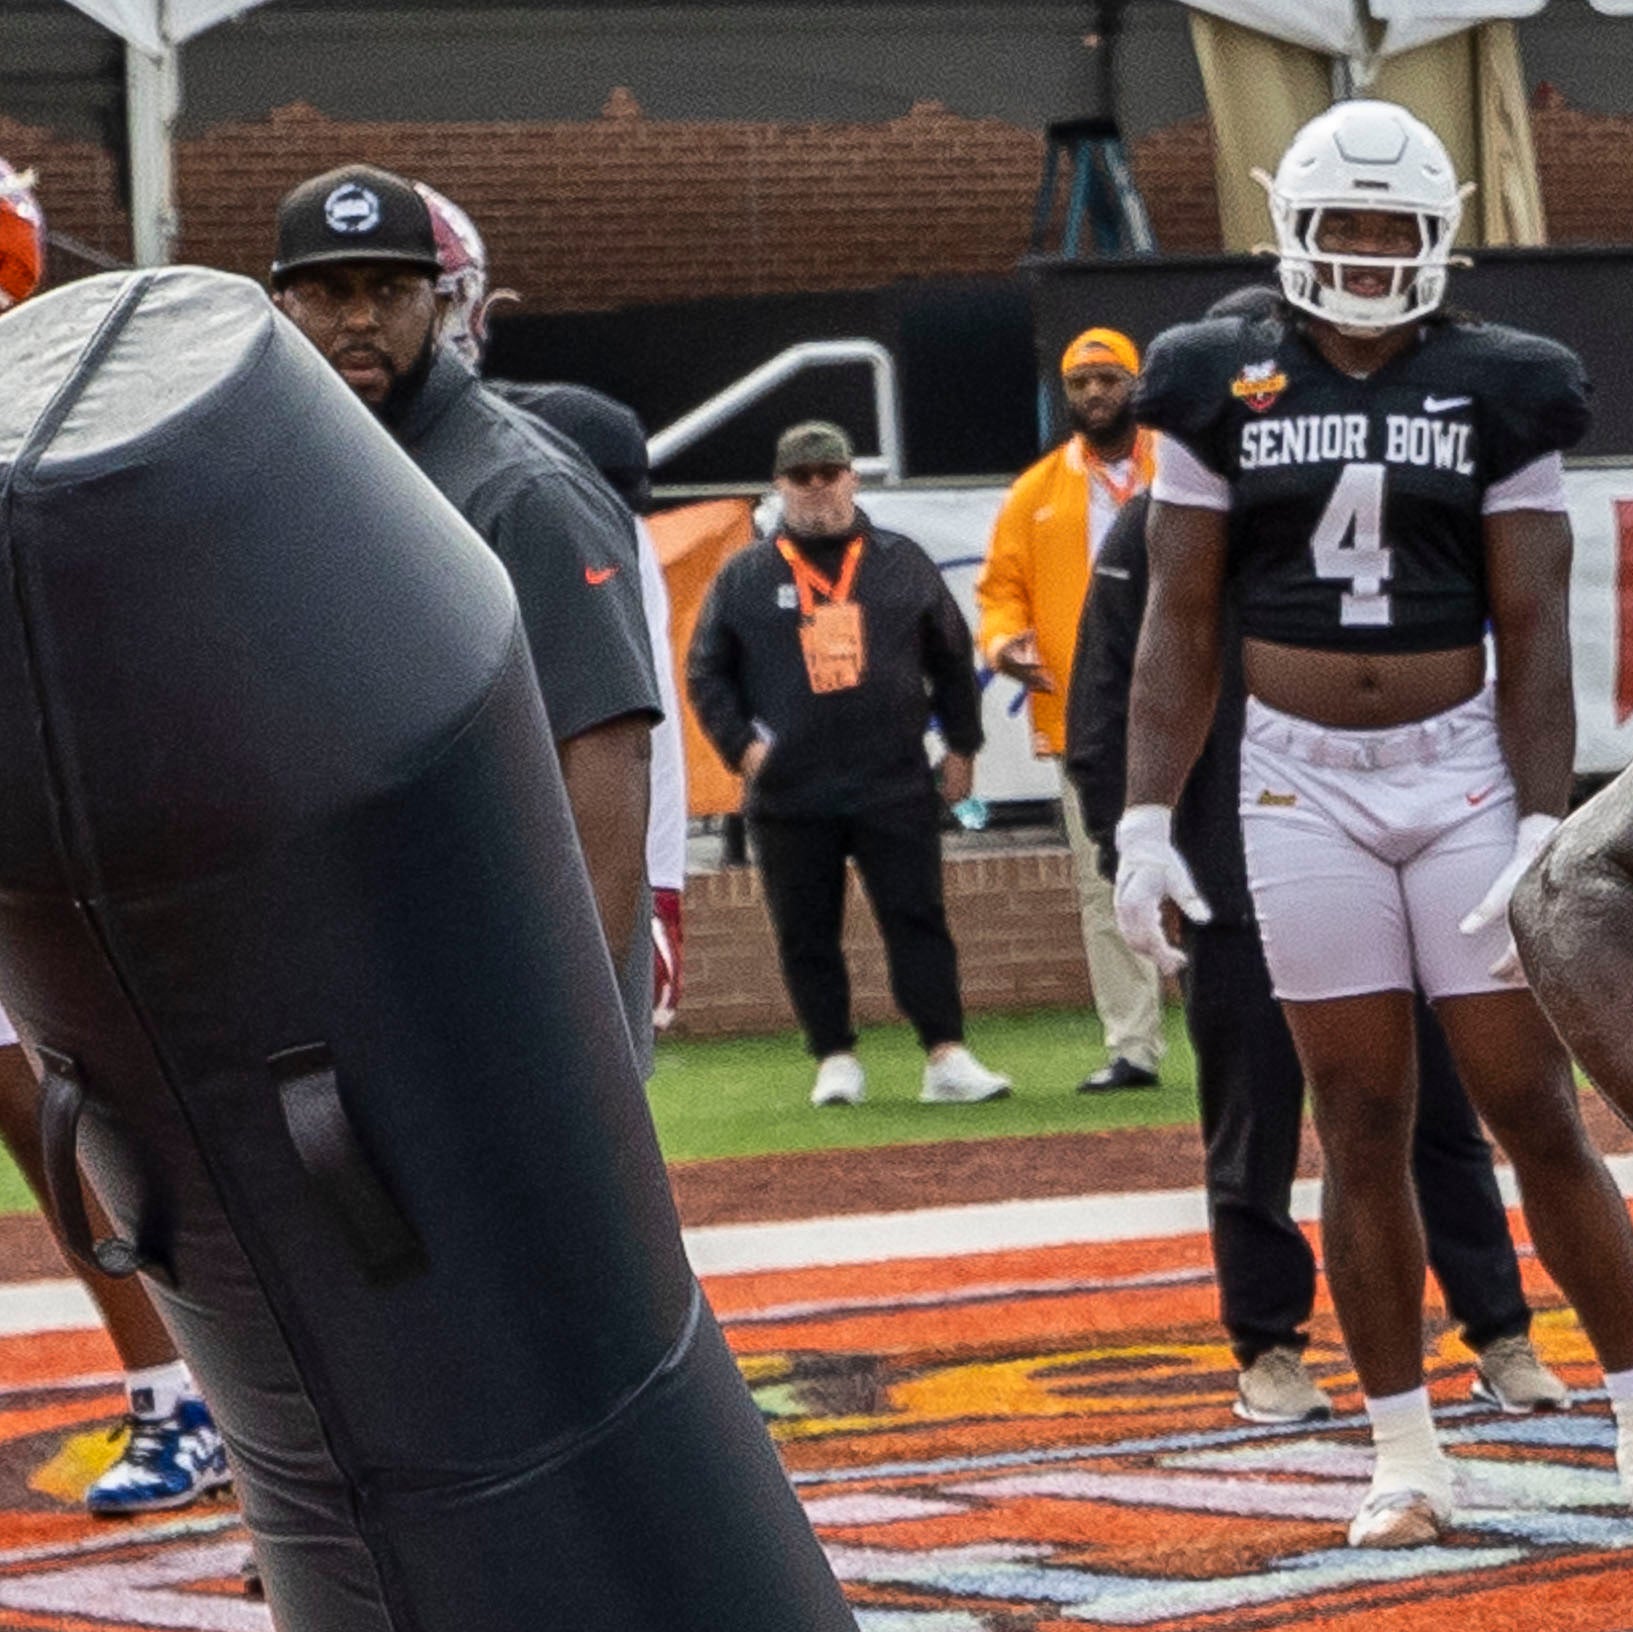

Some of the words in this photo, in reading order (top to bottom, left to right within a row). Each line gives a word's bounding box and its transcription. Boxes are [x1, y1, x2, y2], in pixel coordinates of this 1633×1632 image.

[1239, 414, 1369, 470] SENIOR
[1385, 414, 1476, 475] BOWL
[1310, 463, 1393, 626] 4
